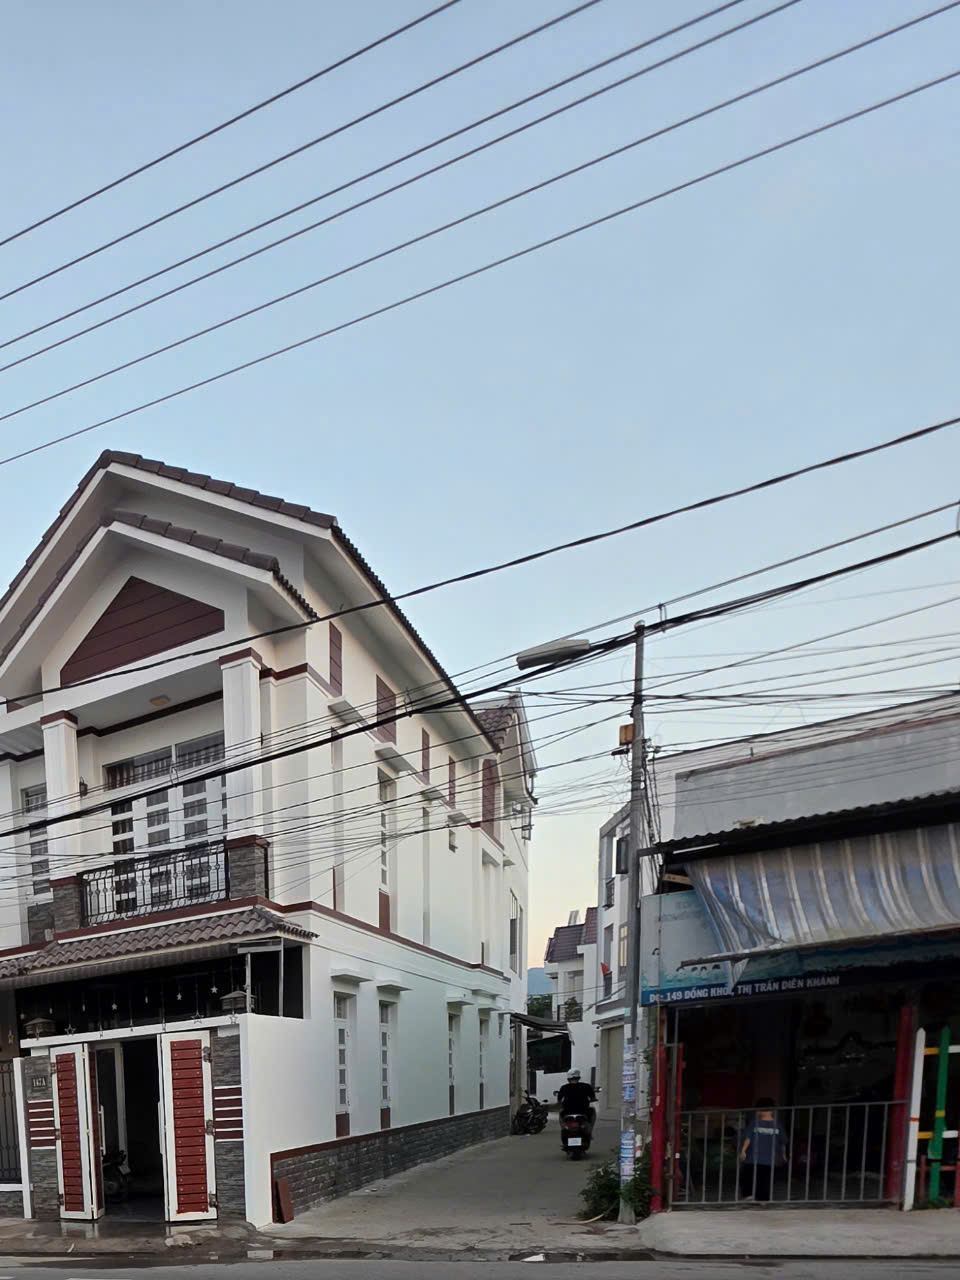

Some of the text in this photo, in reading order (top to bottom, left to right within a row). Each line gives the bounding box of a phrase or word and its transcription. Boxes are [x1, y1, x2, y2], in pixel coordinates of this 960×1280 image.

[666, 991, 682, 1001] 149
[737, 984, 752, 995] THỊ
[806, 975, 840, 987] KHÁNH
